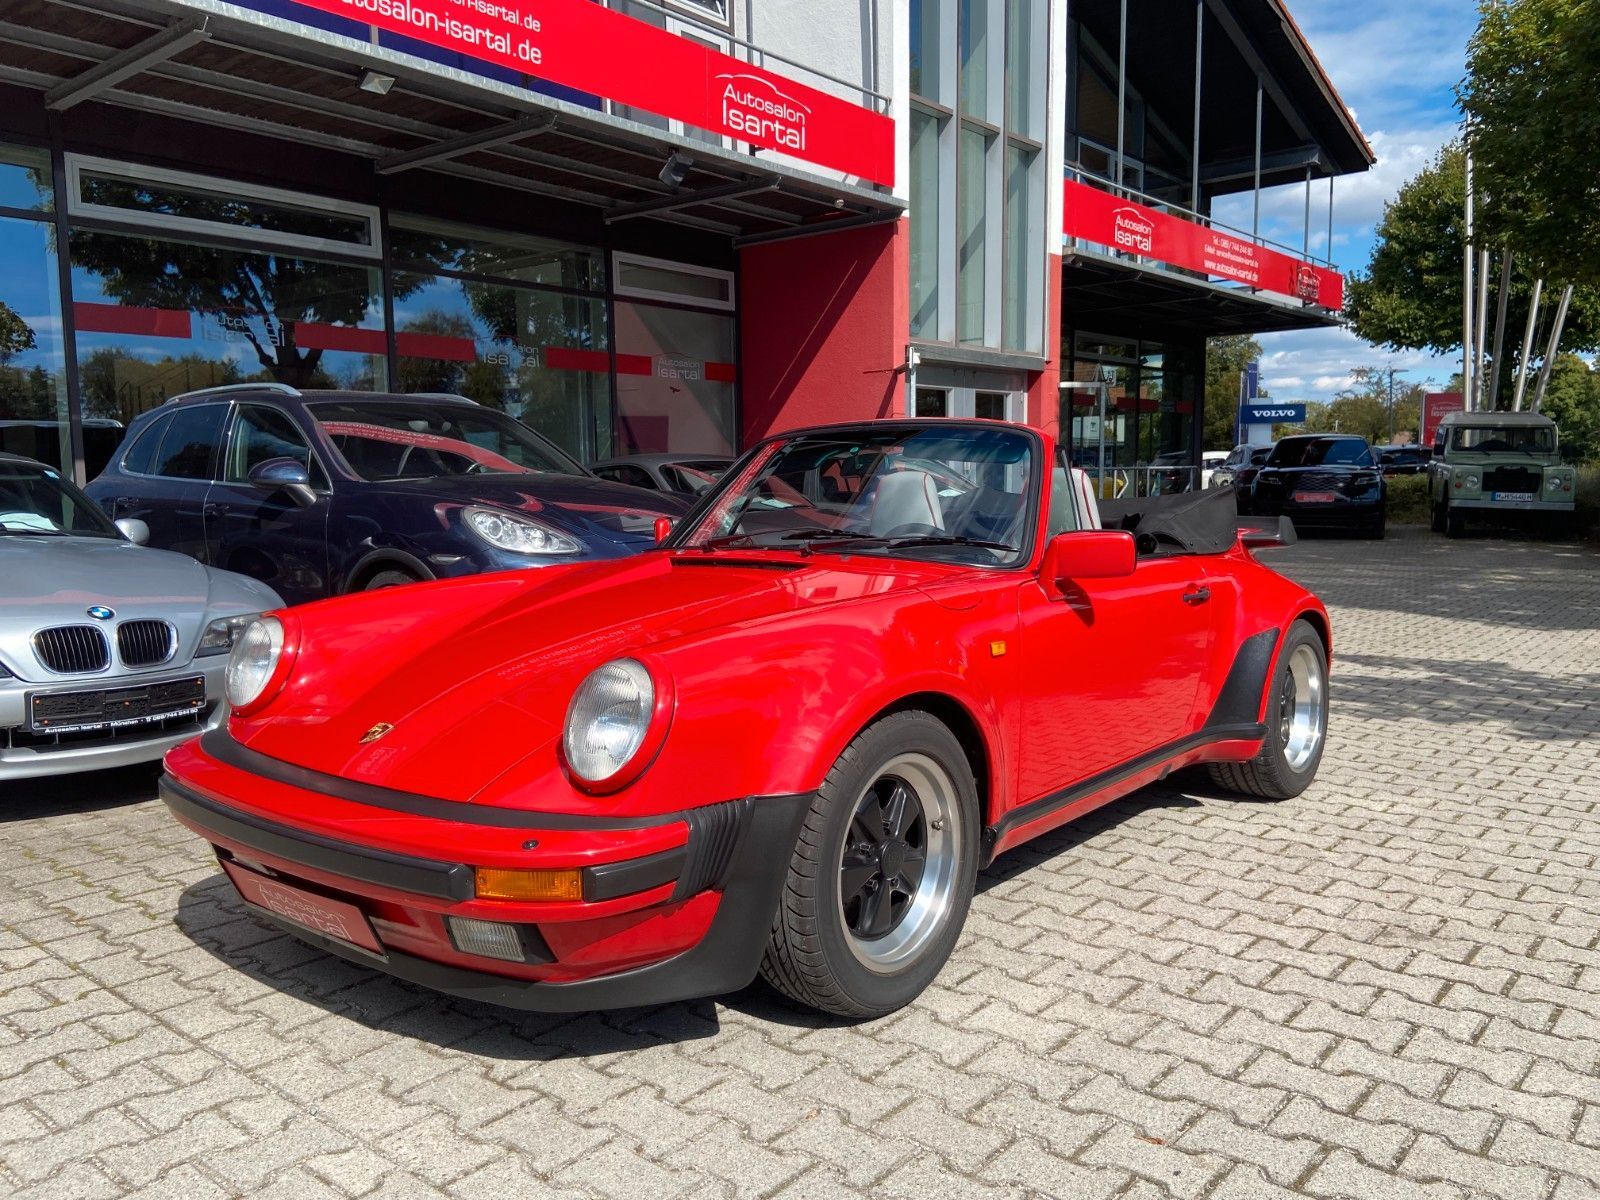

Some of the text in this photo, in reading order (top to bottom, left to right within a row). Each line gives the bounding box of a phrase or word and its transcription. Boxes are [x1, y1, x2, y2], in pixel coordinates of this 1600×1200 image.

[342, 0, 542, 64] osalon-isartal.de
[722, 99, 806, 150] Isartal
[723, 83, 805, 125] Autosalon
[1114, 225, 1152, 252] Isartal
[1115, 215, 1152, 235] Autosalon
[259, 884, 342, 924] Autosalon
[261, 892, 353, 940] Isartal
